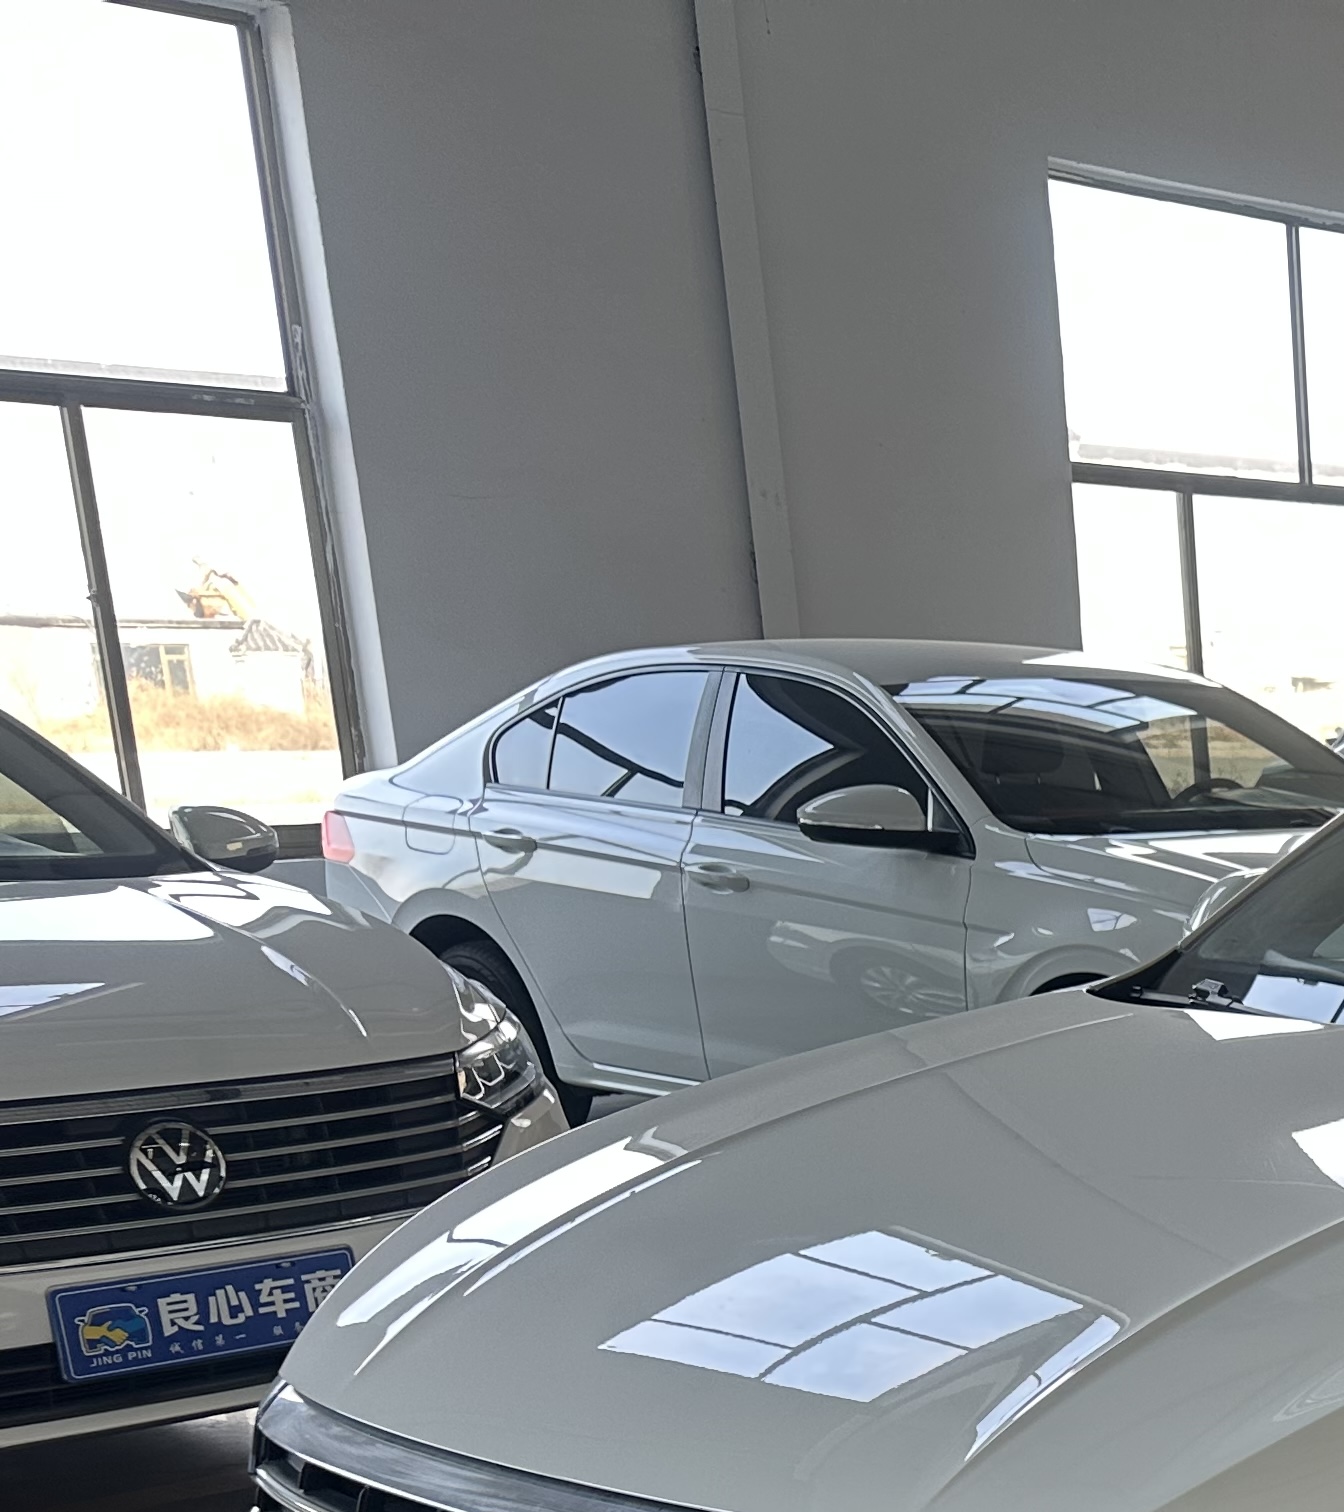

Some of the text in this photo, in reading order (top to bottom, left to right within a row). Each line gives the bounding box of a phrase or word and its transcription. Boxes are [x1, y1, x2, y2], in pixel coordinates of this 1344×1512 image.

[130, 1121, 226, 1210] VW
[90, 1349, 152, 1367] JING PIN
